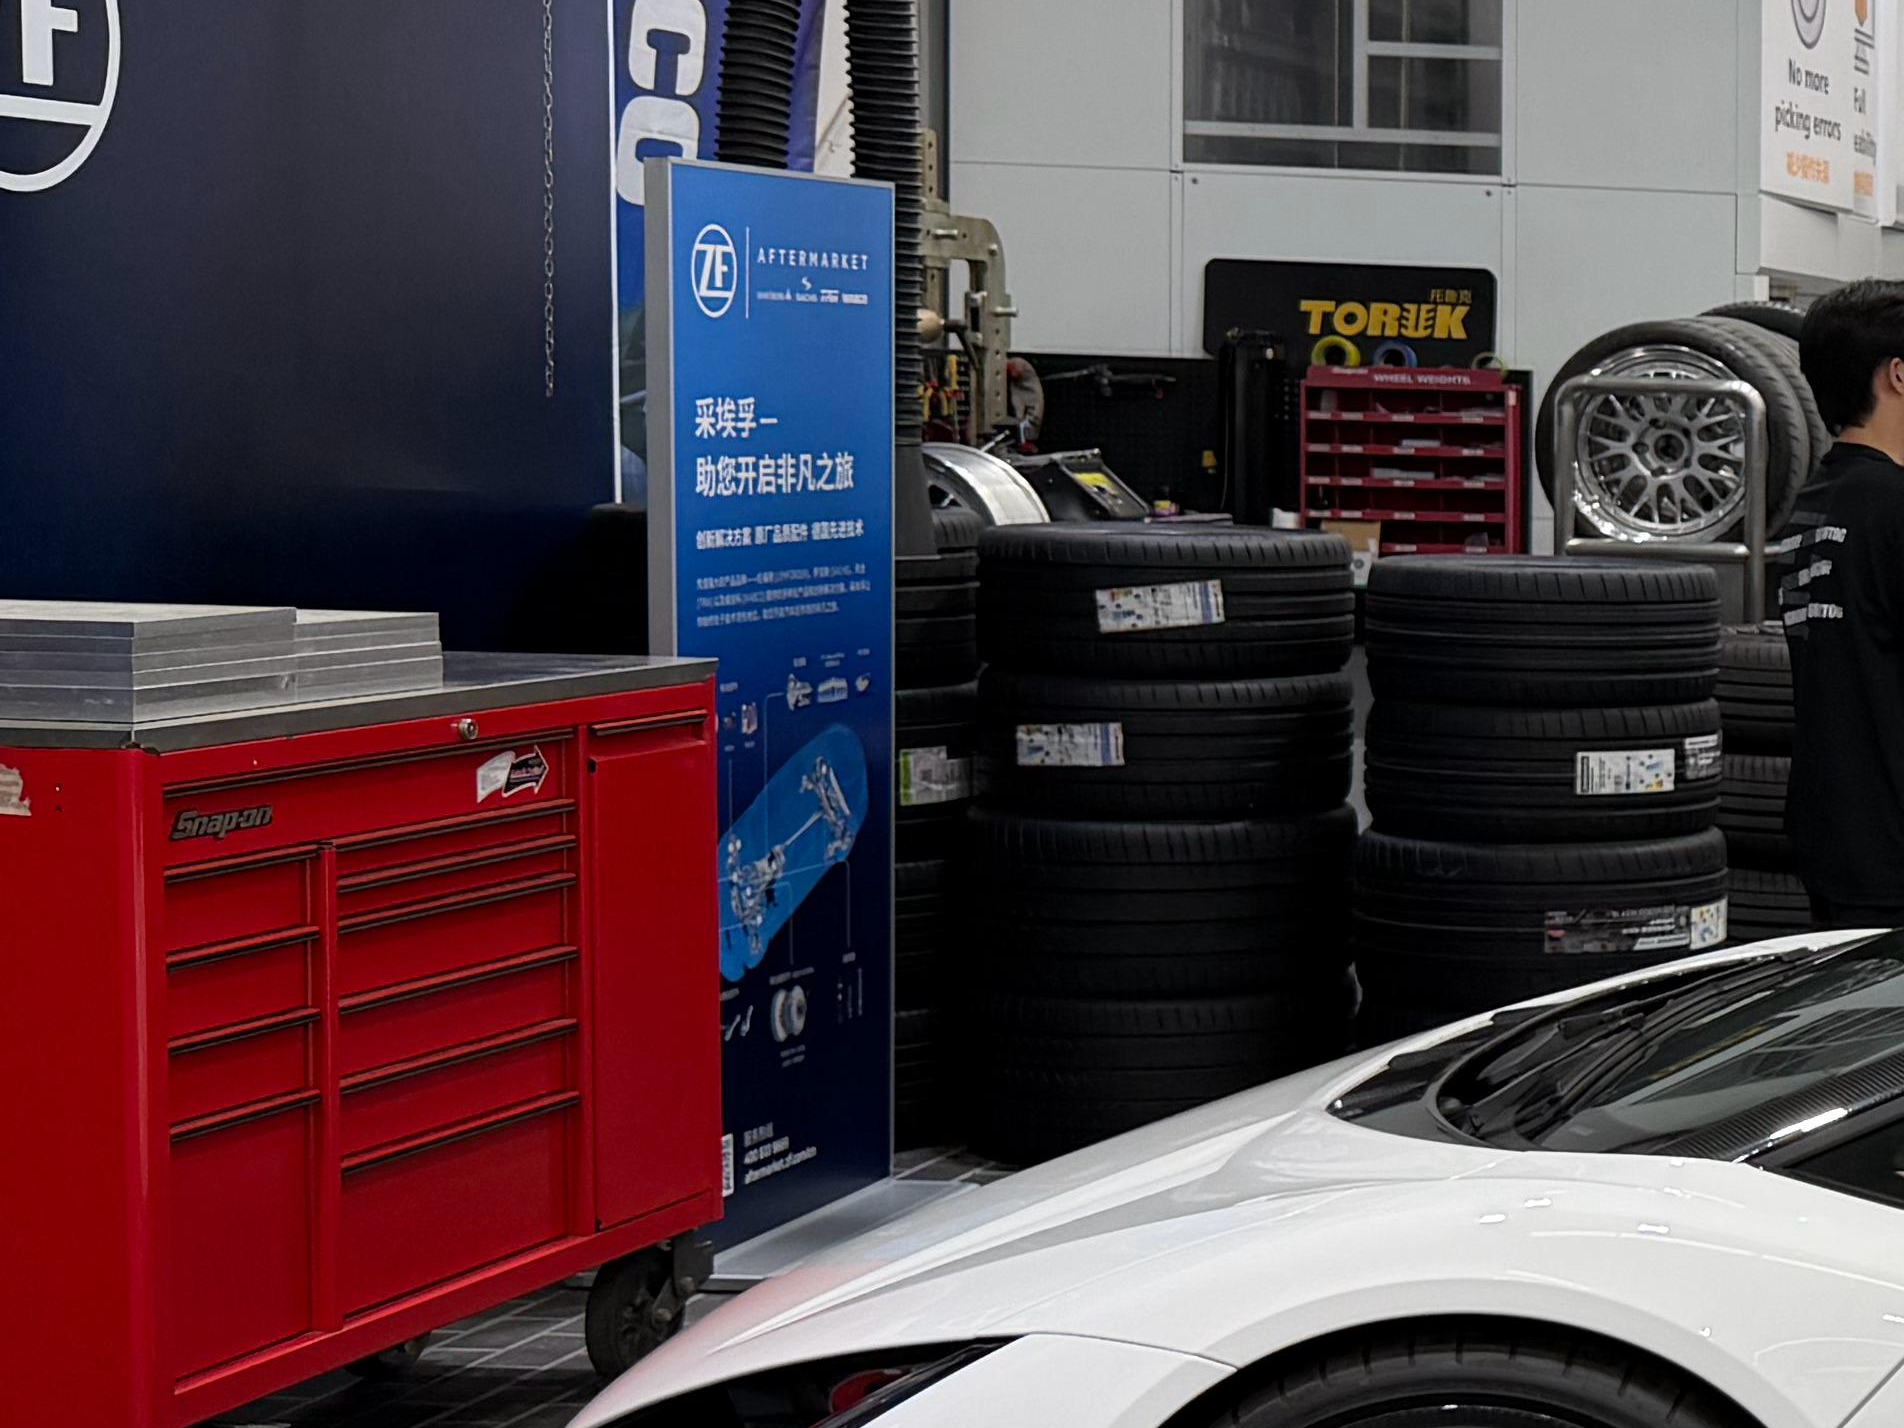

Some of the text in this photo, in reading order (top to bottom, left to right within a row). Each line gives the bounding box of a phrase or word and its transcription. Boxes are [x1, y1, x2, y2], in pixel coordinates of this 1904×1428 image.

[1788, 58, 1830, 95] No more
[1775, 99, 1842, 141] picking errors
[757, 246, 870, 271] AFTERMARKET
[1300, 299, 1471, 340] TORUK
[1373, 372, 1471, 385] WHEEL WEIGHTS
[695, 451, 855, 498] 助您开启非凡之旅
[170, 805, 273, 840] Snap-on
